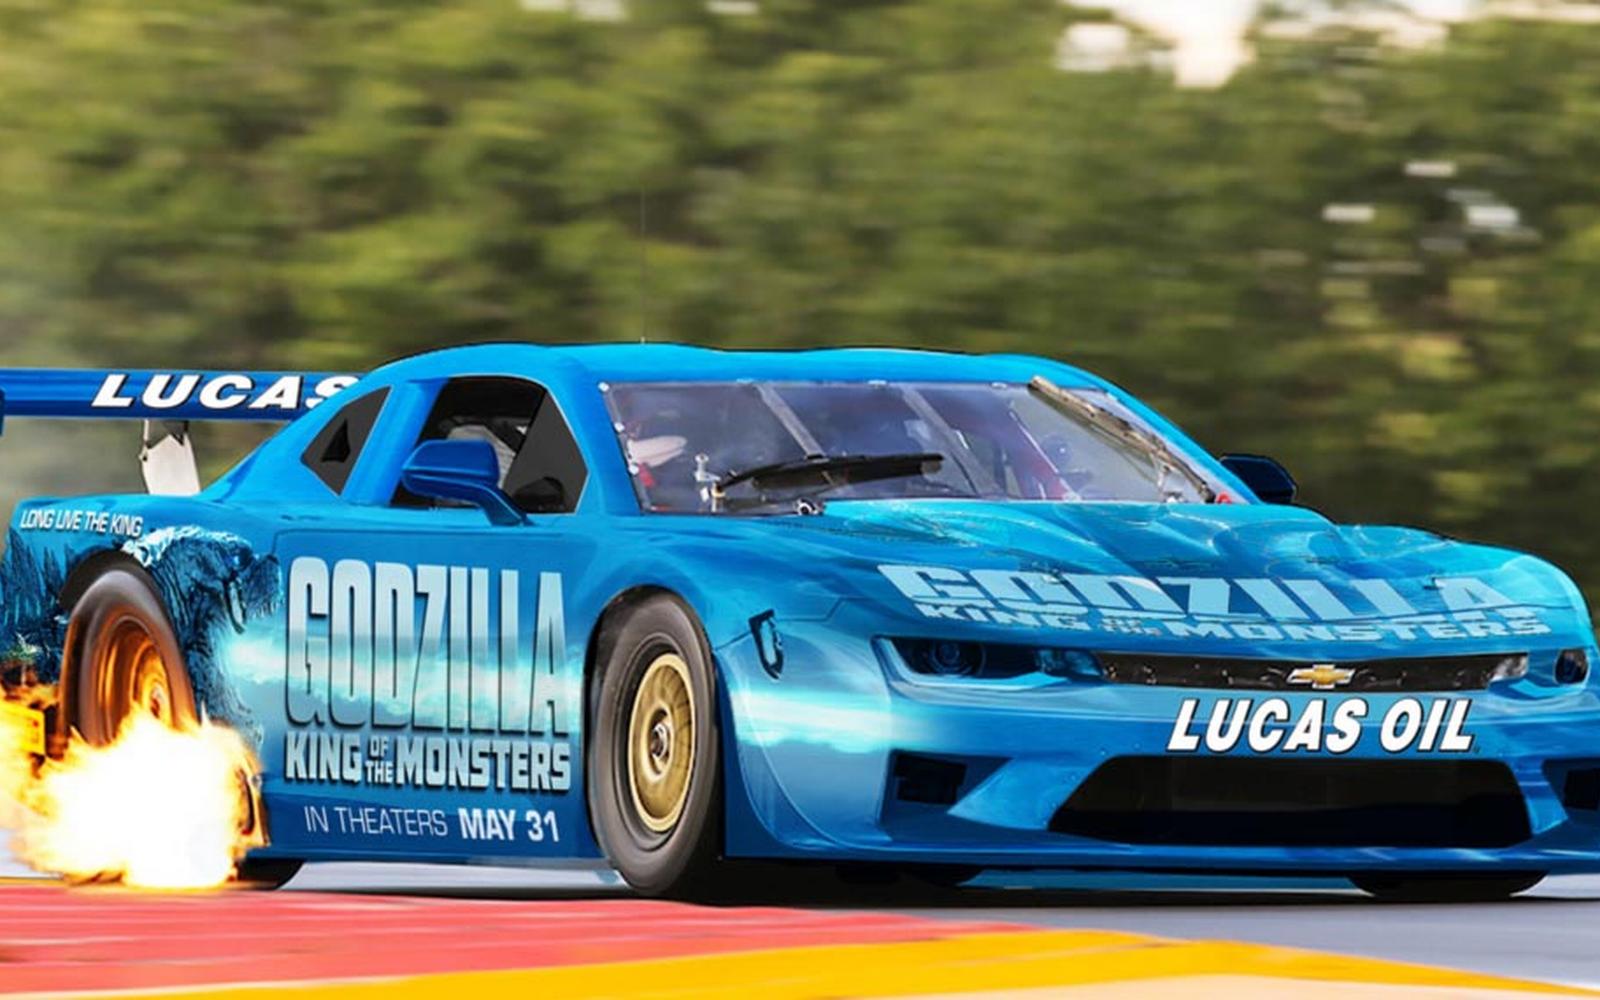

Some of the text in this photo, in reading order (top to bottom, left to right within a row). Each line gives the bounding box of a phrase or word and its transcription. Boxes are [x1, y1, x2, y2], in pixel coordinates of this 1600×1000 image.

[20, 509, 143, 537] LONG LIVE THE KING
[877, 564, 1538, 622] GODZILLA
[286, 556, 569, 735] GODZILLA
[915, 603, 1091, 631] KING
[1162, 619, 1552, 642] MONSTERS
[1166, 698, 1474, 754] LUCAS OIL
[285, 732, 571, 791] KING OF THE MONSTERS
[304, 806, 559, 842] IN THEATERS MAY 31
